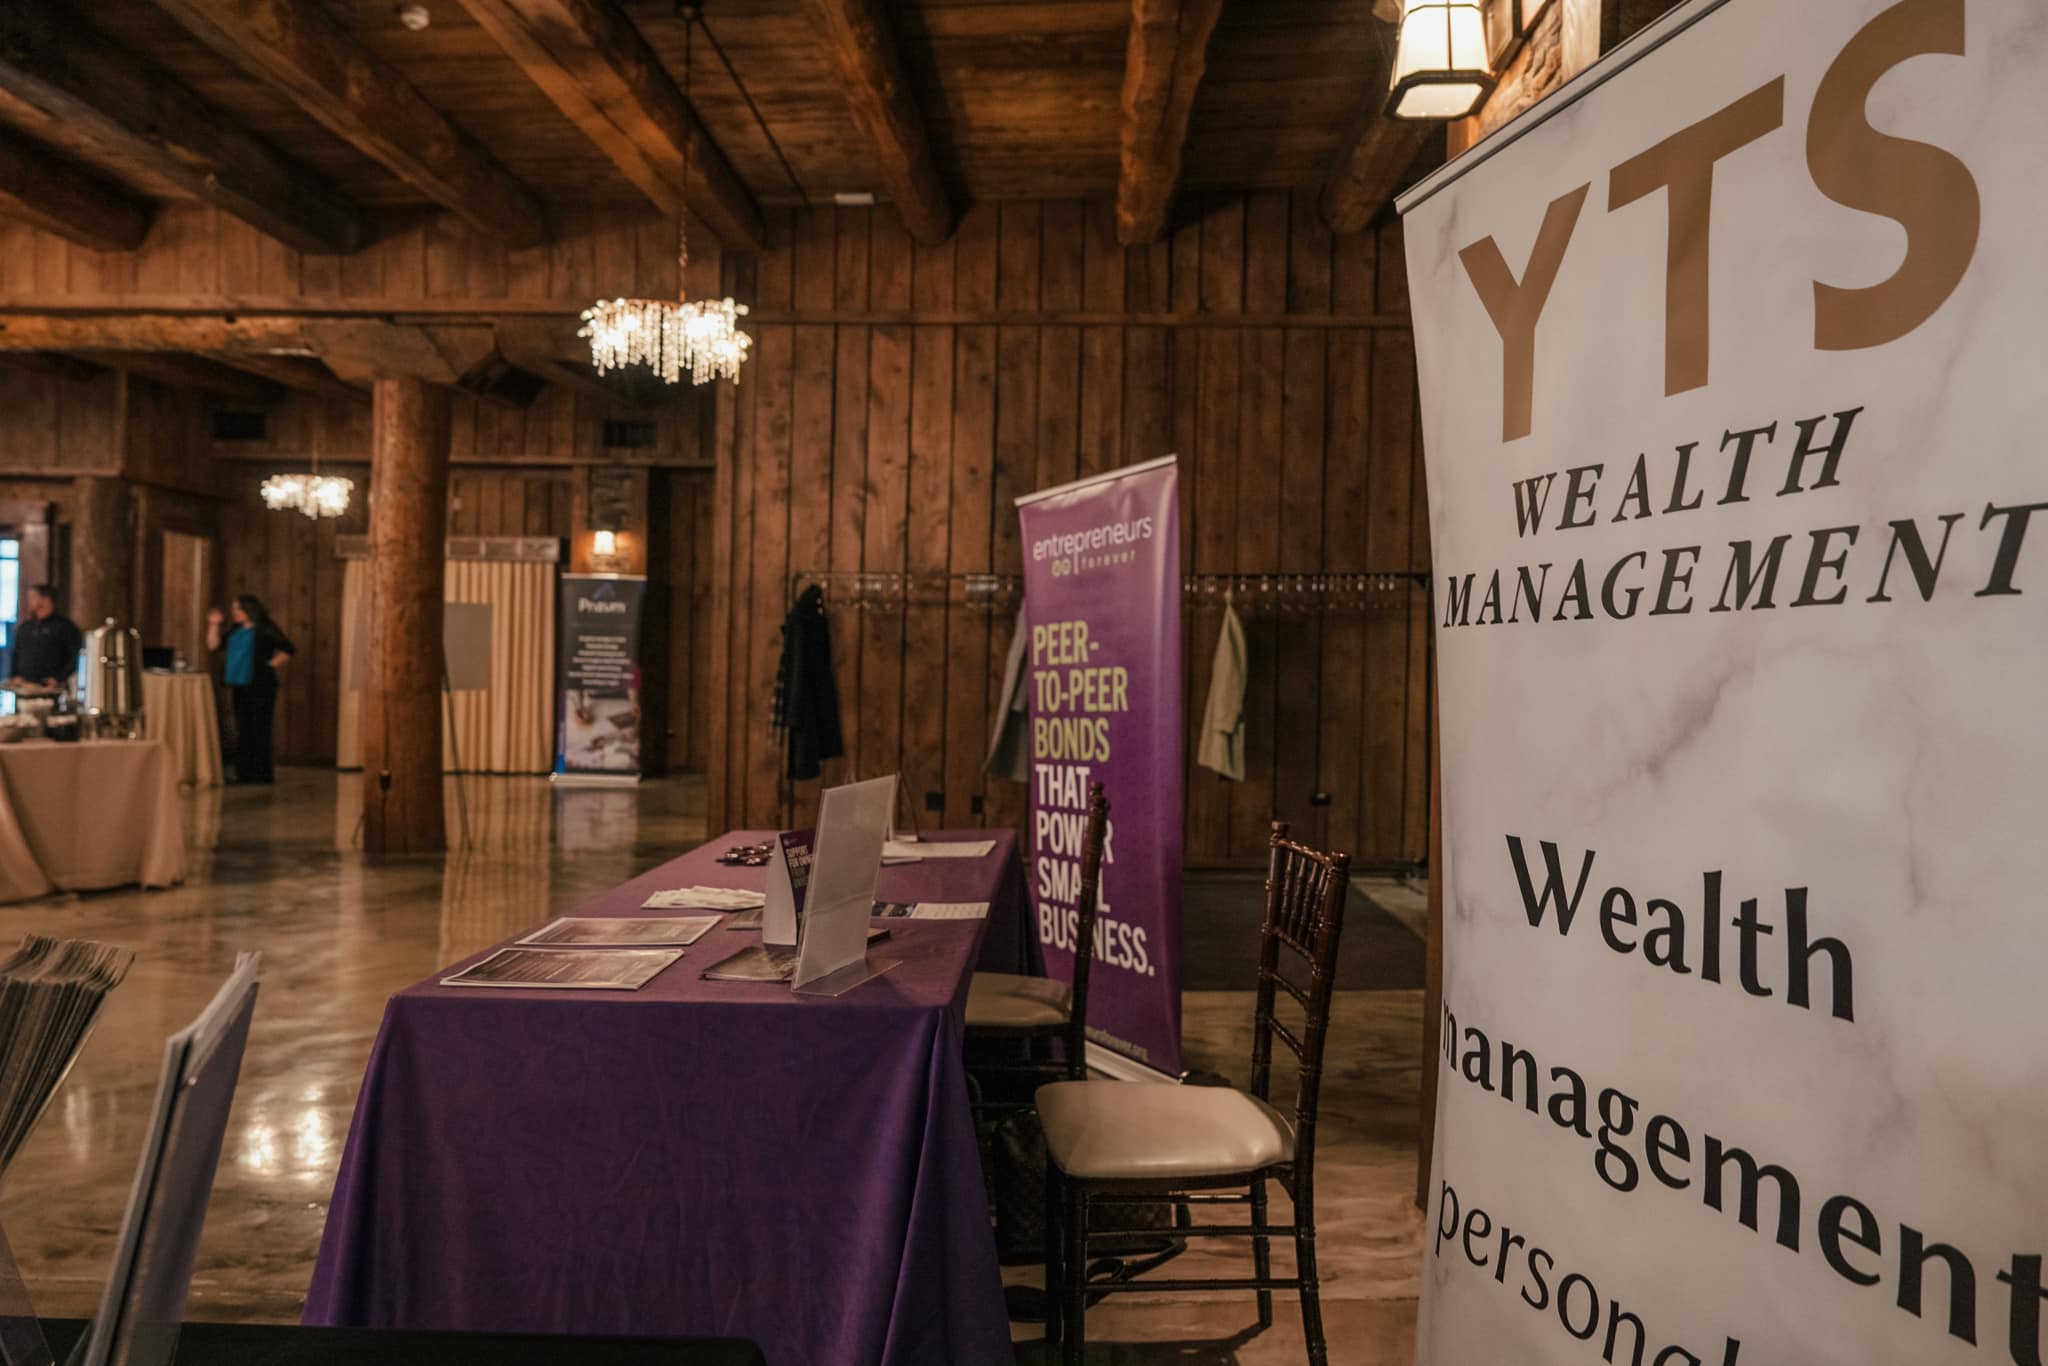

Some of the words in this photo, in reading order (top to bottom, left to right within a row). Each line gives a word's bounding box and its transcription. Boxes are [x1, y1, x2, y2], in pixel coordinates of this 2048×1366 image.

[1458, 0, 1981, 443] YTS
[1511, 406, 1865, 539] WEALTH
[1032, 514, 1153, 573] entrepreneurs
[1442, 501, 2048, 629] MANAGEMENT
[1032, 619, 1100, 666] PEER-
[1033, 666, 1129, 713] TO-PEER
[1034, 716, 1111, 763] BONDS
[1035, 764, 1091, 809] THAT
[1036, 810, 1114, 865] POWR
[1037, 858, 1111, 913] SMAL
[1038, 902, 1155, 977] BUSNESS.
[1505, 834, 1855, 1024] Wealth
[1442, 999, 2048, 1366] management
